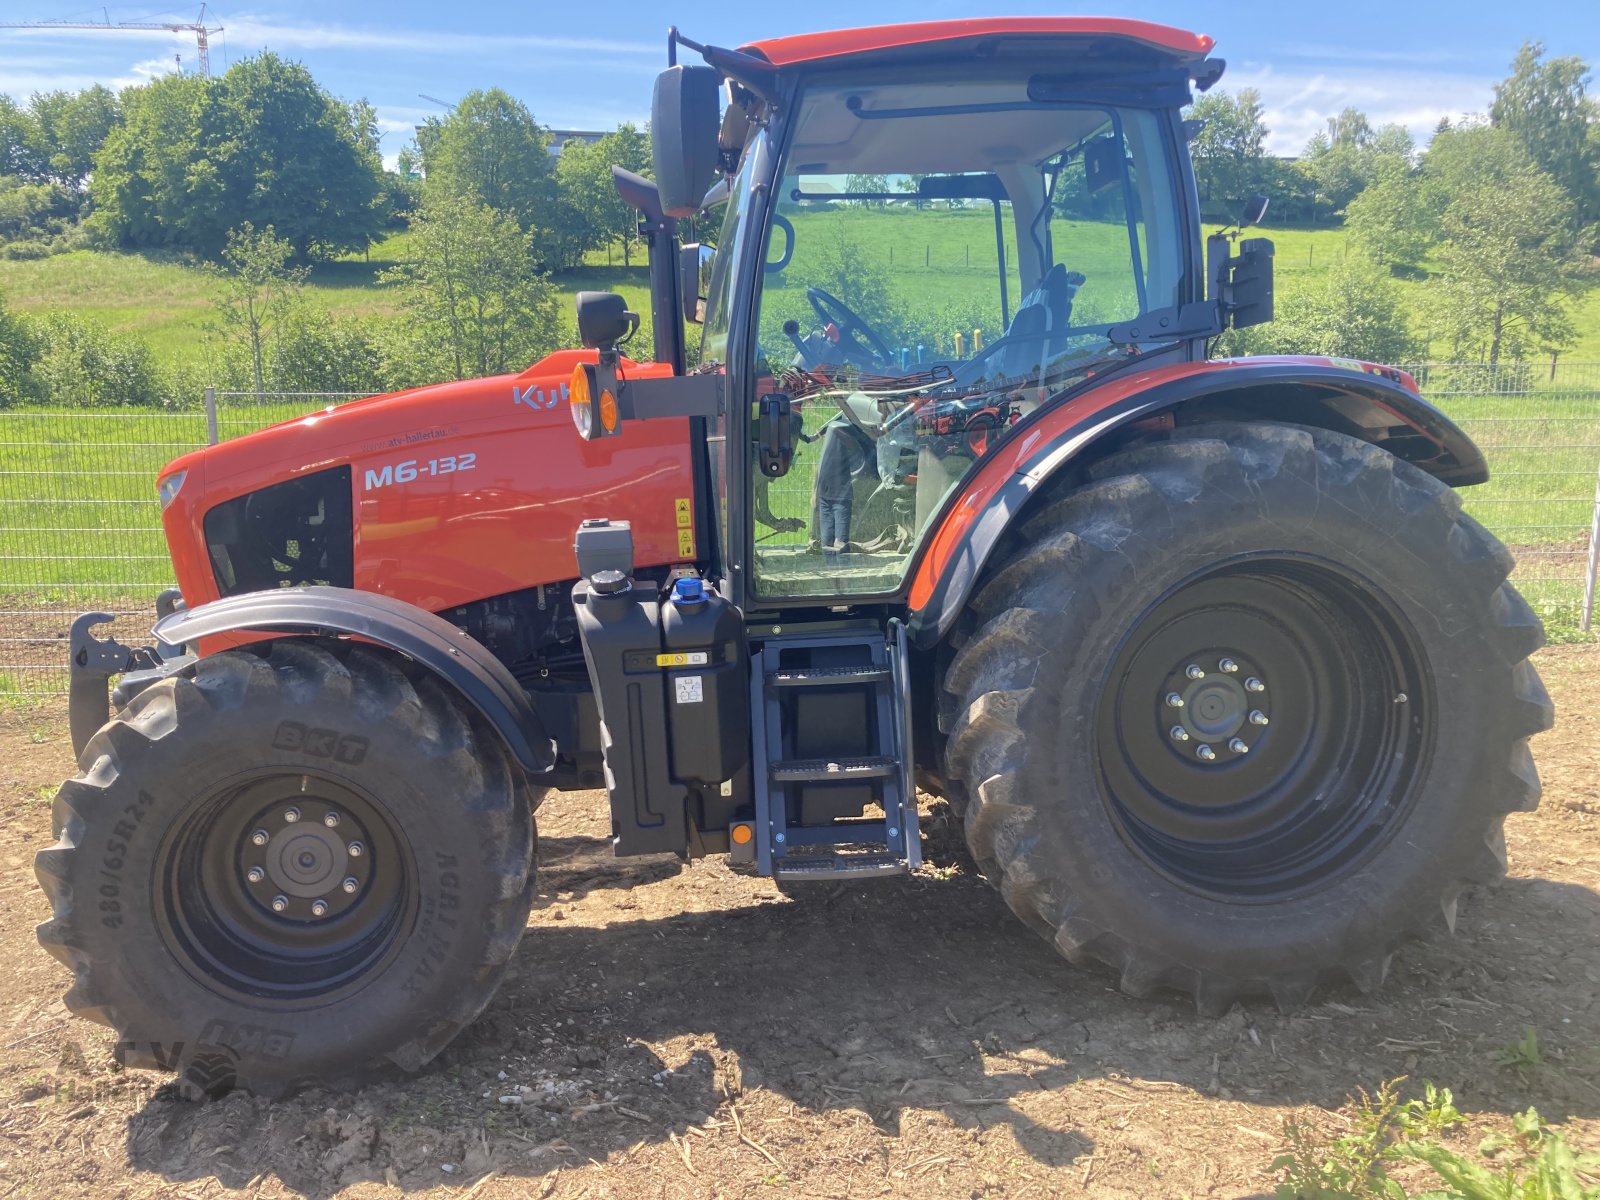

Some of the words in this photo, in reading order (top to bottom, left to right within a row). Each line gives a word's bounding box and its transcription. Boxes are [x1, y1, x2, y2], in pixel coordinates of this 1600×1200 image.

[365, 453, 477, 490] M6-132
[272, 720, 371, 766] BKT
[197, 1019, 298, 1063] BKT
